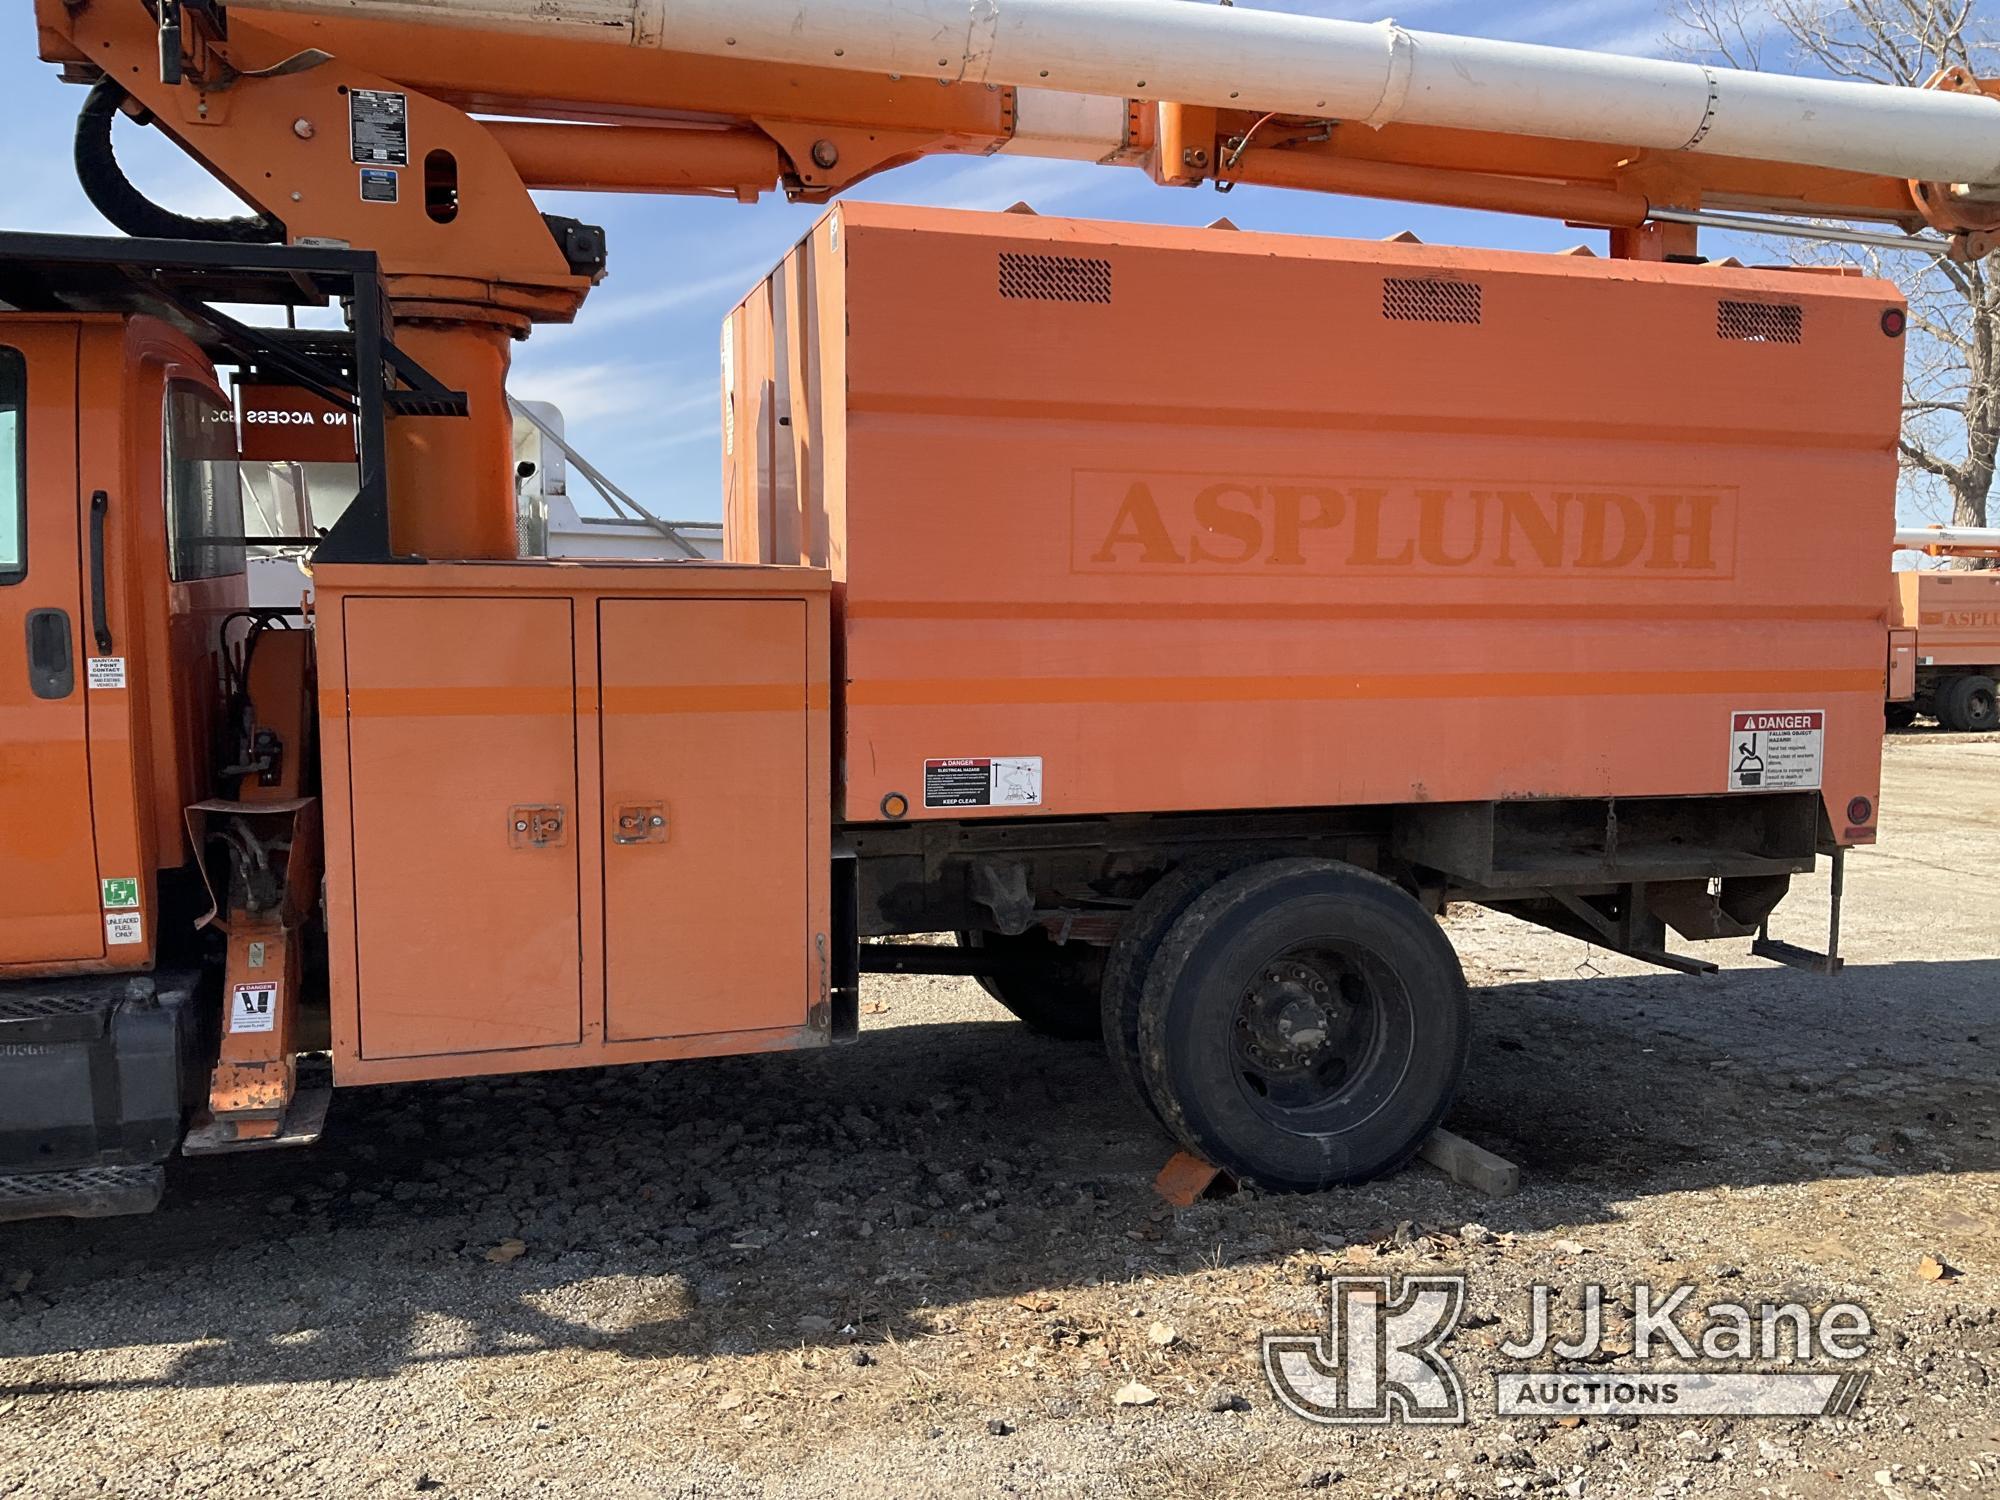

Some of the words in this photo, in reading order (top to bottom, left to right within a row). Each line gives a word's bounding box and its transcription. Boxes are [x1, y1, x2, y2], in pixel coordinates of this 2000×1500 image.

[1091, 481, 1720, 570] ASPLUNDH
[1758, 716, 1811, 729] DANGER
[107, 917, 139, 925] UNLEADED
